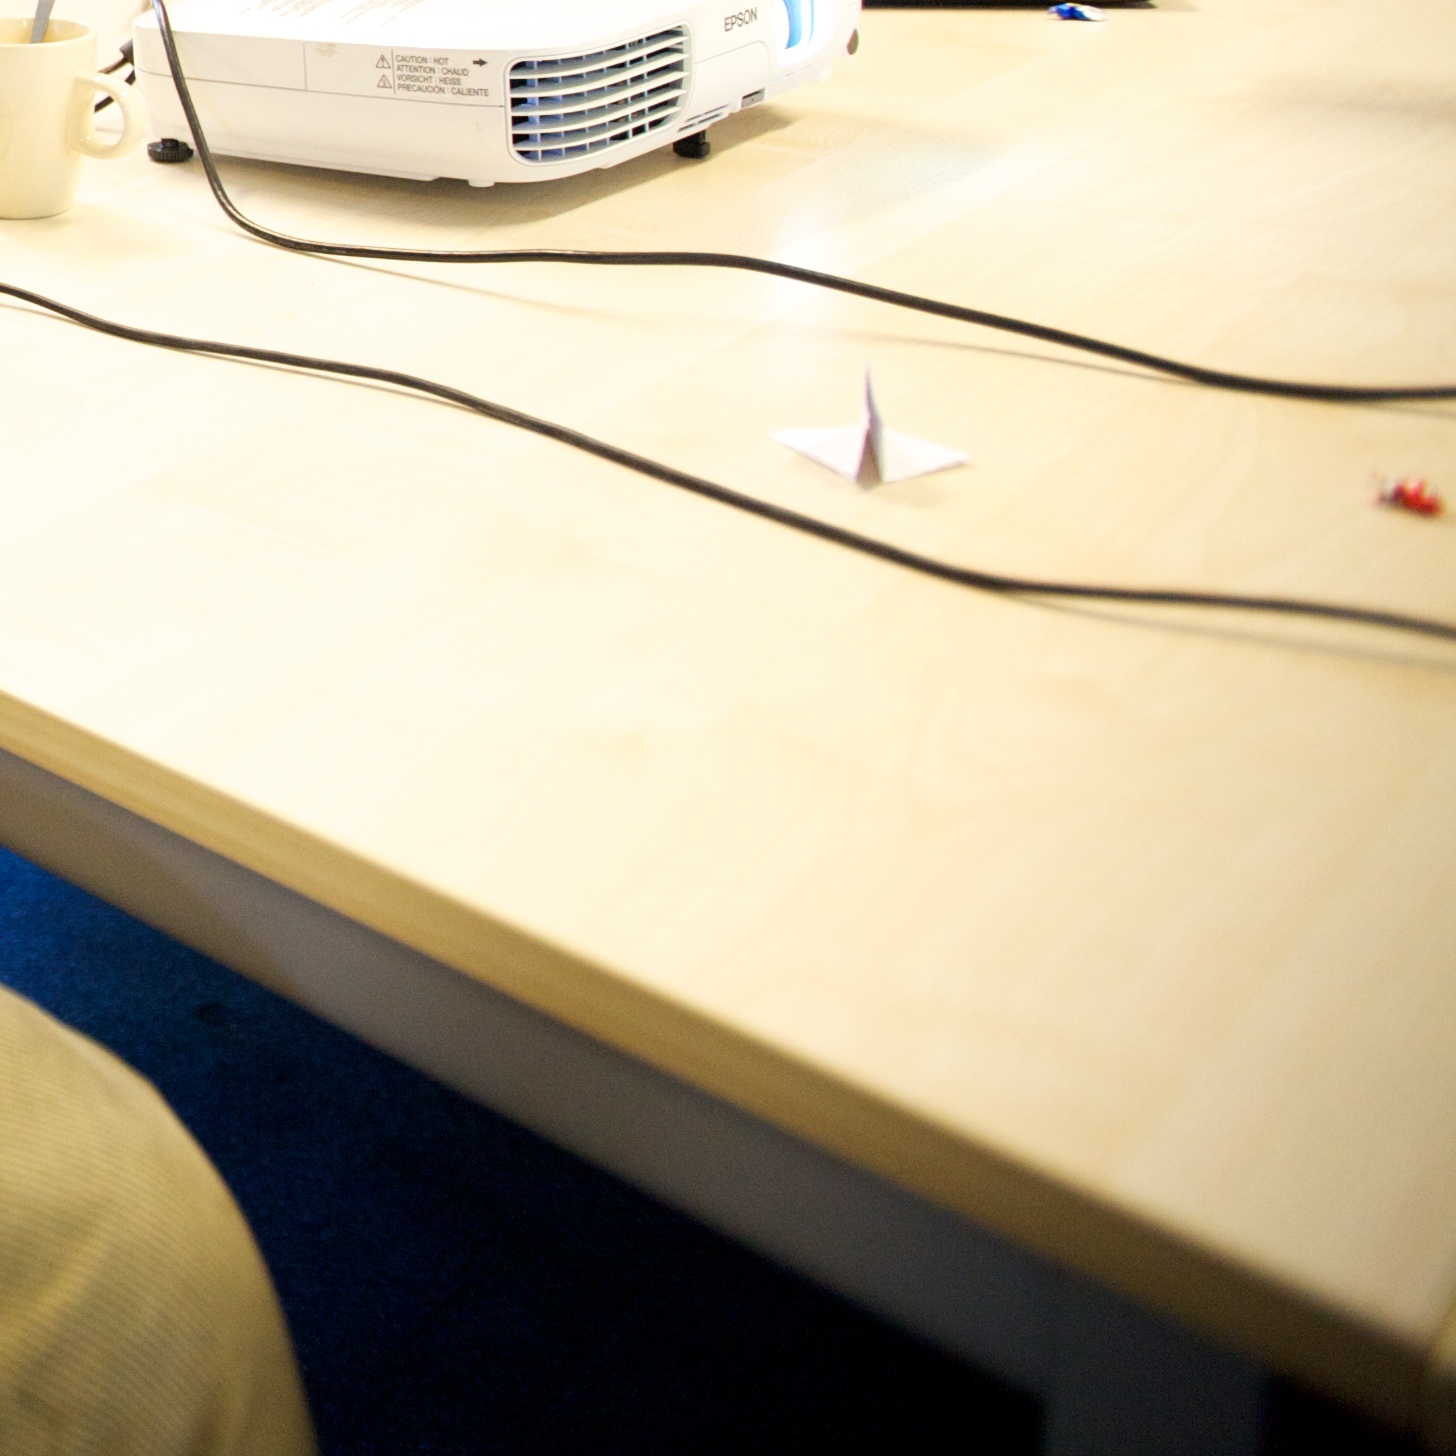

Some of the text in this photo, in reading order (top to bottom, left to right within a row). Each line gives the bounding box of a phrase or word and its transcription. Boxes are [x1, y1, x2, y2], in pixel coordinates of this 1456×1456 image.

[724, 7, 757, 32] EPSON
[395, 54, 428, 64] CAUTION
[433, 57, 449, 65] HOT
[396, 65, 436, 74] ATTENTION
[441, 67, 469, 76] CHAUD
[396, 74, 433, 83] VORSICHT
[439, 76, 462, 85] HEISS
[451, 87, 490, 96] CALIENTE
